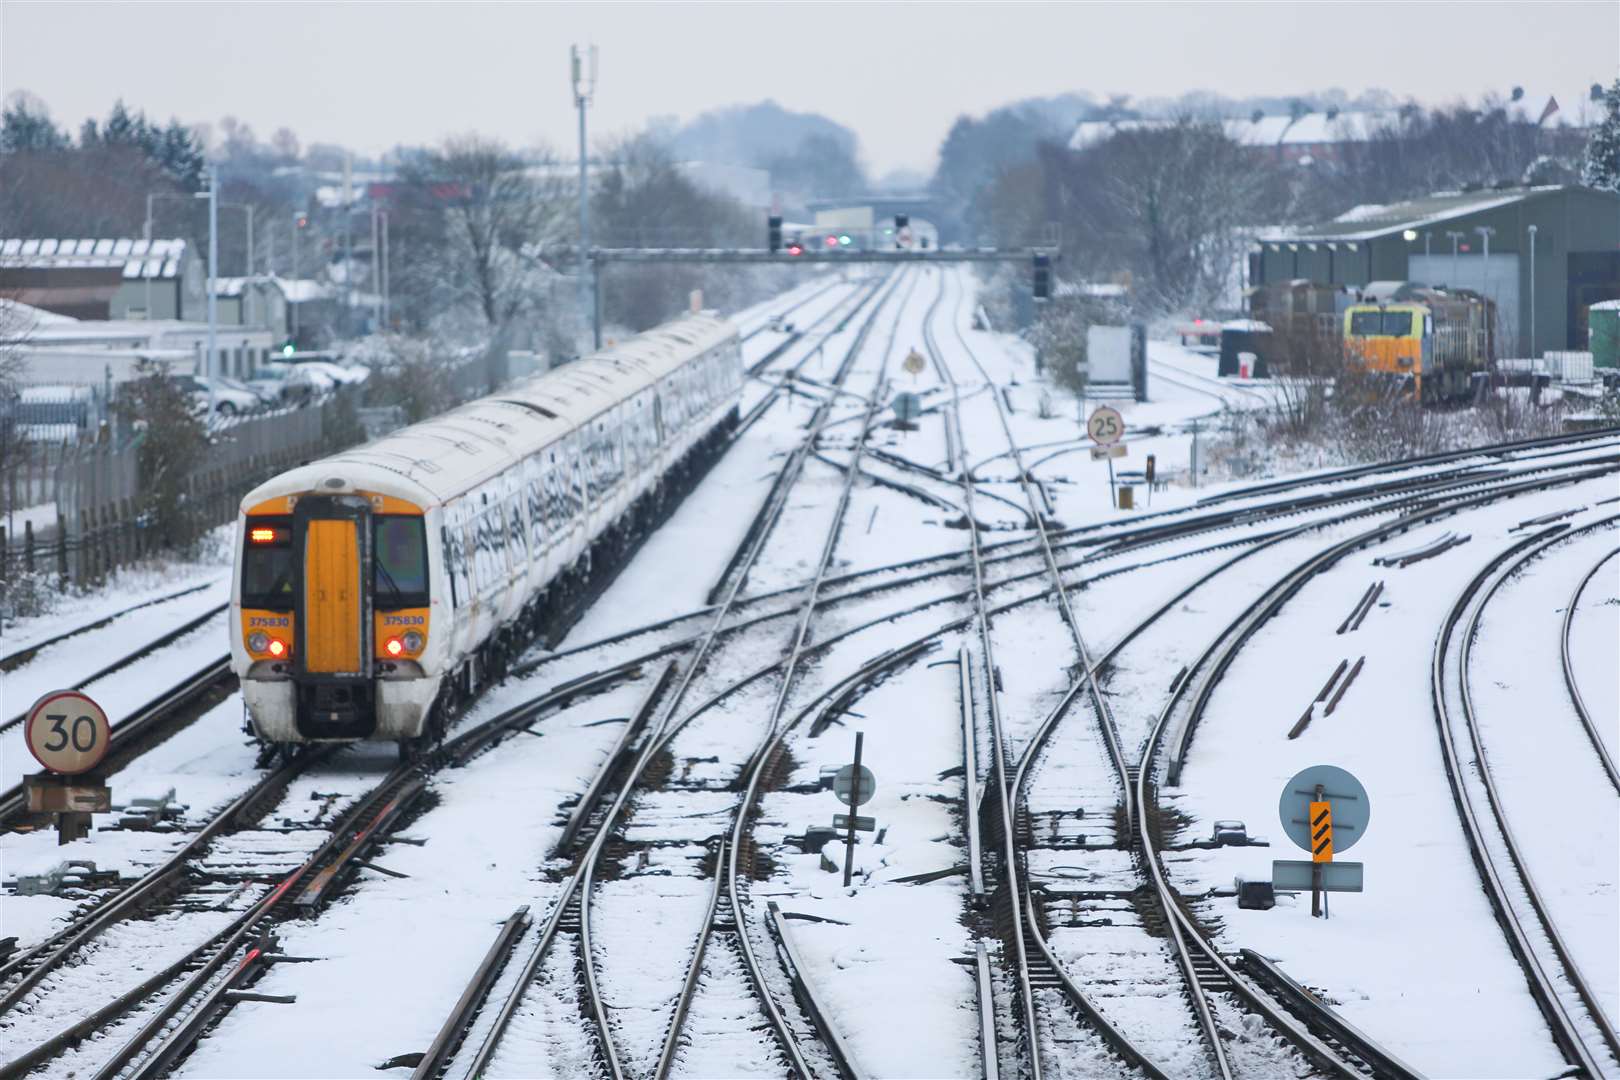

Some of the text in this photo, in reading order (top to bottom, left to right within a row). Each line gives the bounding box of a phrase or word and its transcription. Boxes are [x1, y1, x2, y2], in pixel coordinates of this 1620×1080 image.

[1094, 417, 1117, 436] 25
[249, 616, 288, 628] 375830
[385, 616, 424, 625] 375830
[44, 715, 96, 752] 30
